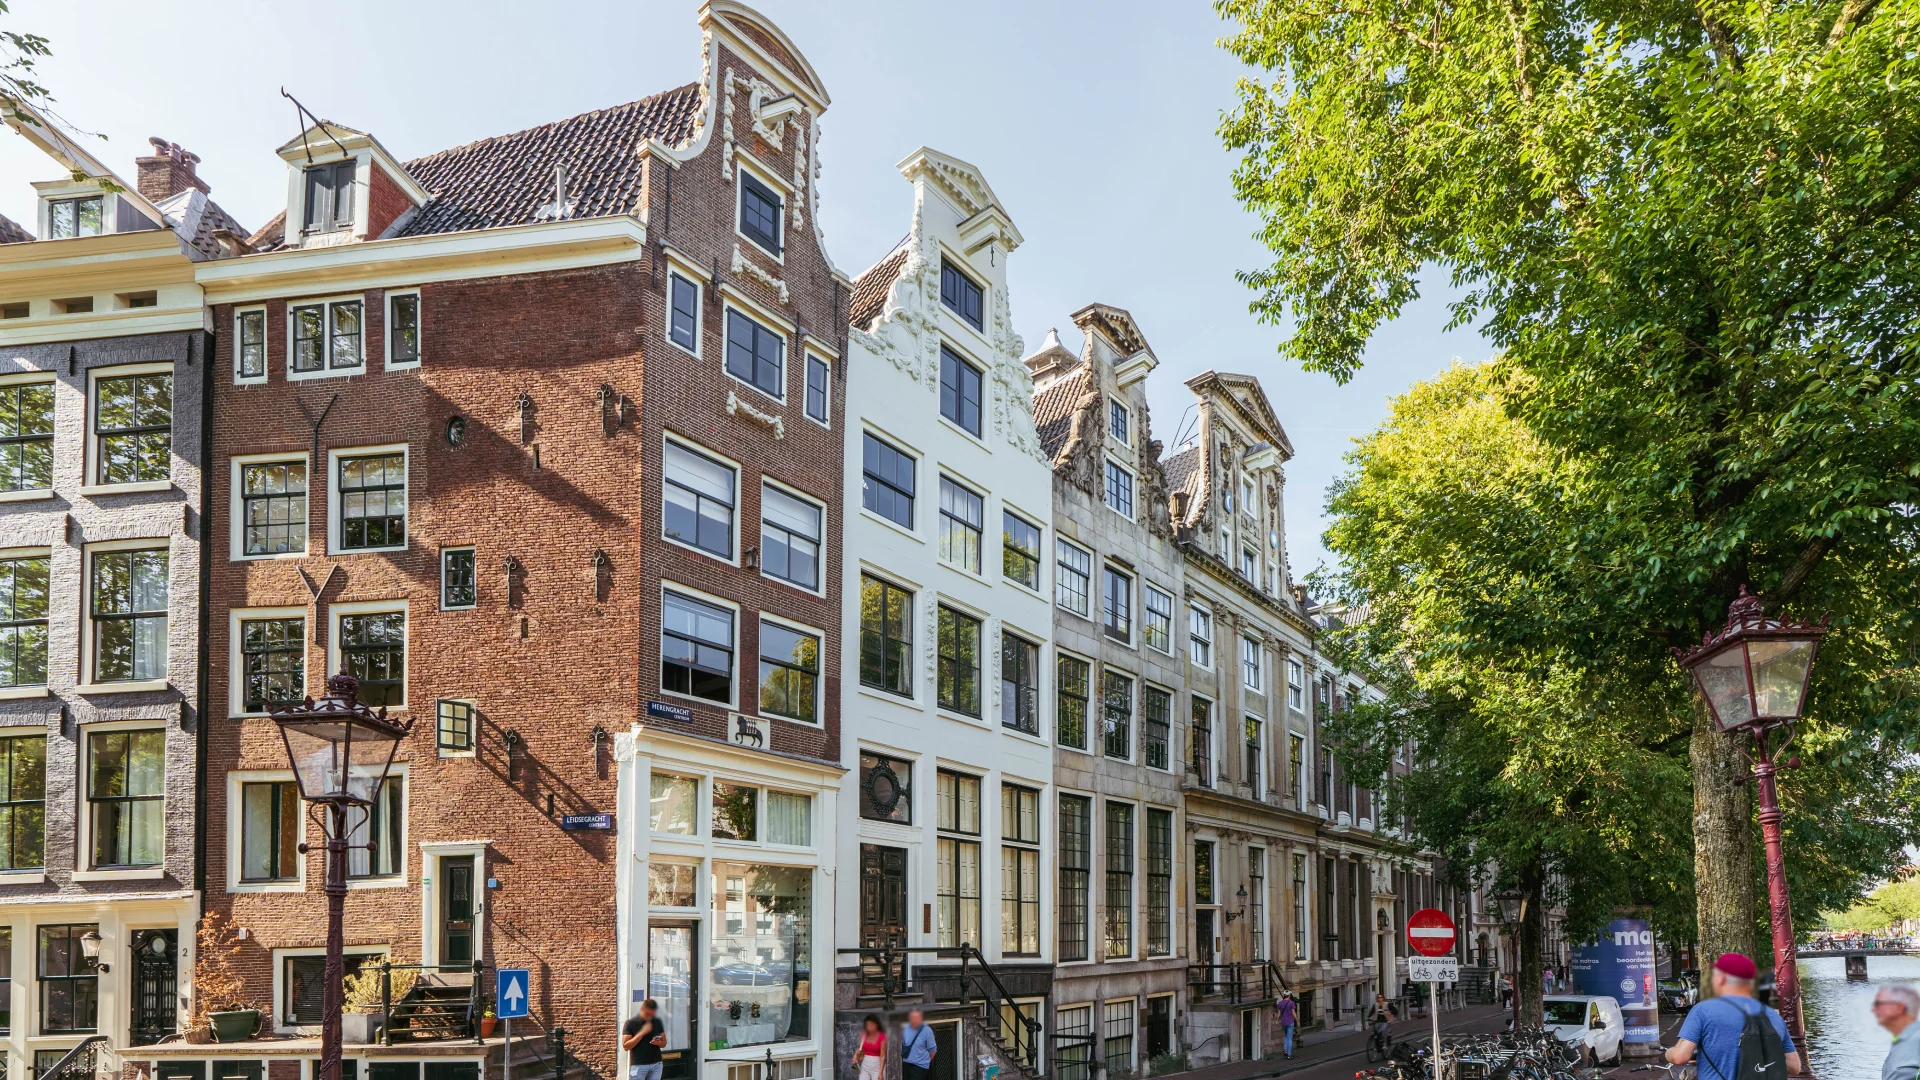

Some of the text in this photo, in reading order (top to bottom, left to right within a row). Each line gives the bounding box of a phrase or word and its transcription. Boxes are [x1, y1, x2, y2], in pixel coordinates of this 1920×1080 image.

[652, 702, 690, 716] HERENGRACHT
[566, 815, 606, 824] LEIDSEGRACHT
[182, 947, 188, 957] 2
